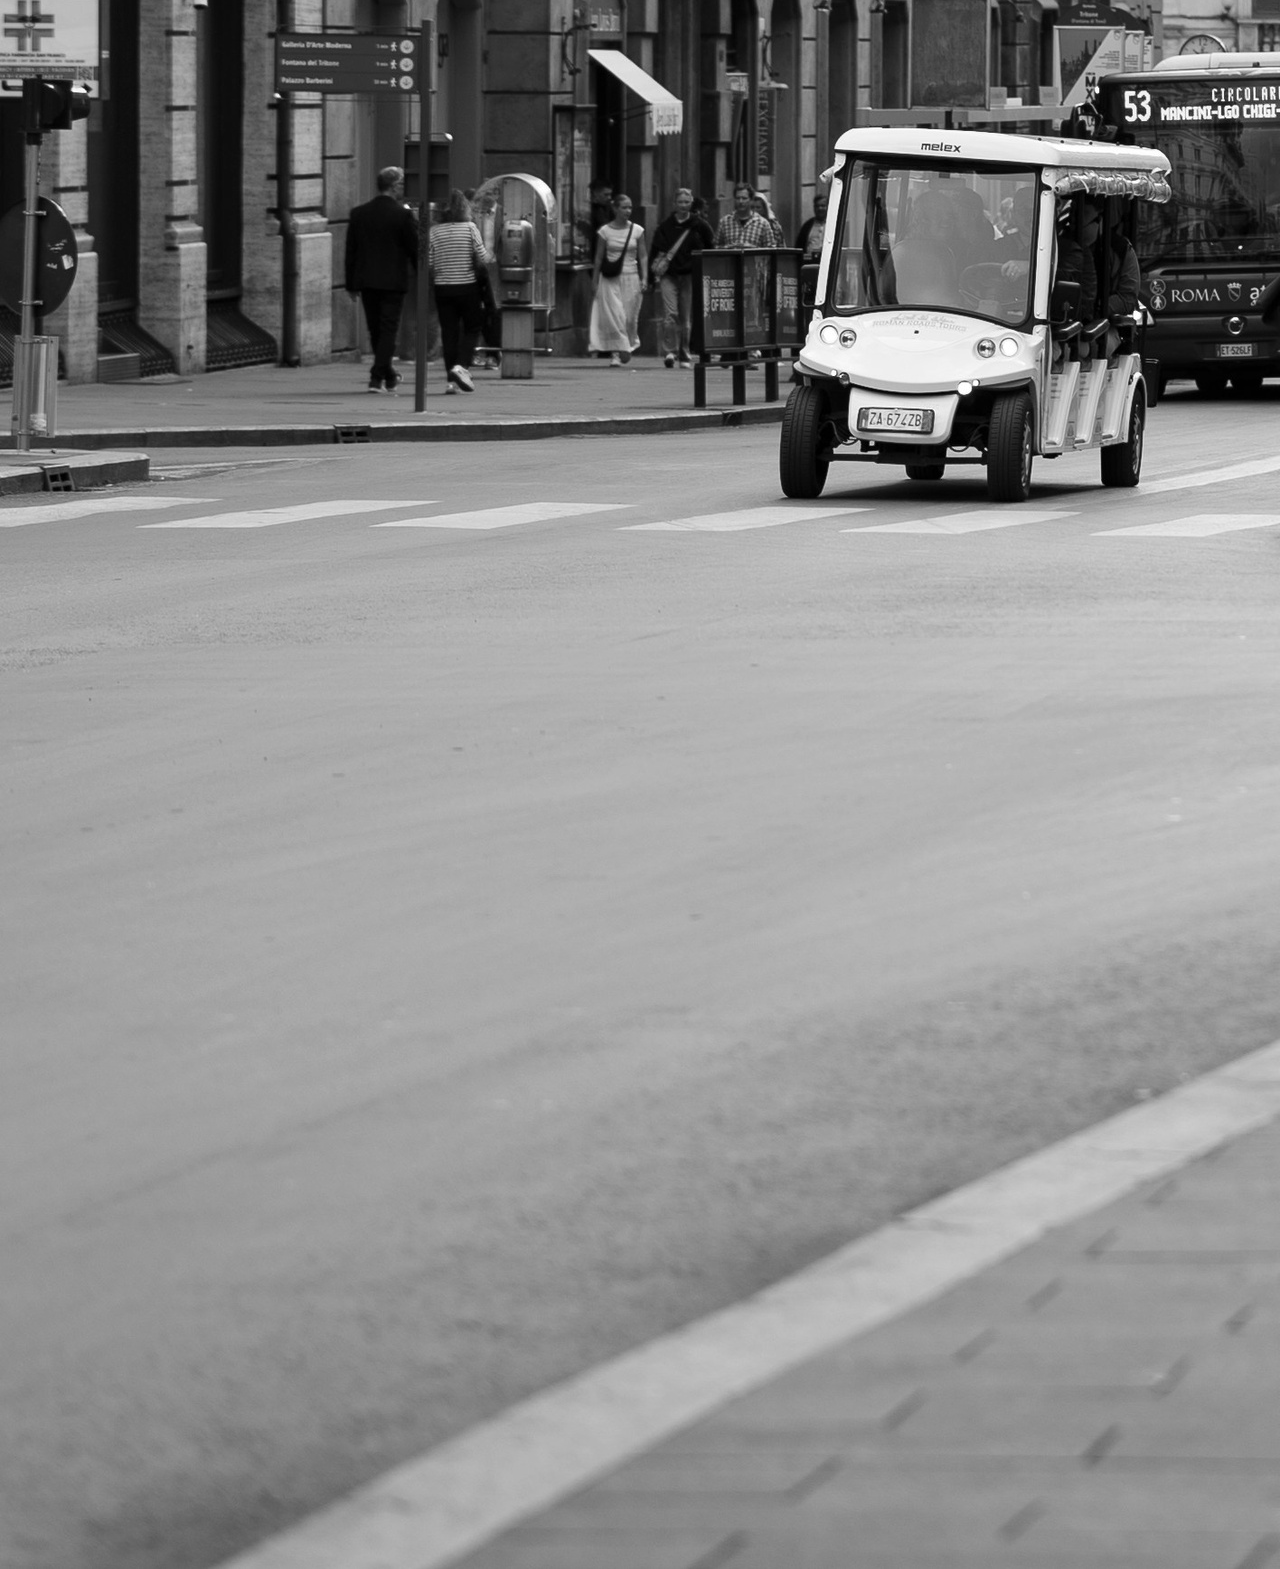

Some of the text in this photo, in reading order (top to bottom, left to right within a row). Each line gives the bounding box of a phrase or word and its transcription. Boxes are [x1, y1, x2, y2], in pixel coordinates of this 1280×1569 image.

[325, 41, 352, 49] Moderna
[281, 76, 305, 84] Palazzo
[305, 77, 334, 85] Barberini
[1124, 90, 1151, 122] 53
[1160, 104, 1240, 121] MANCINI-LGO
[921, 142, 961, 153] melex
[1171, 288, 1221, 303] ROMA
[711, 298, 720, 312] OF
